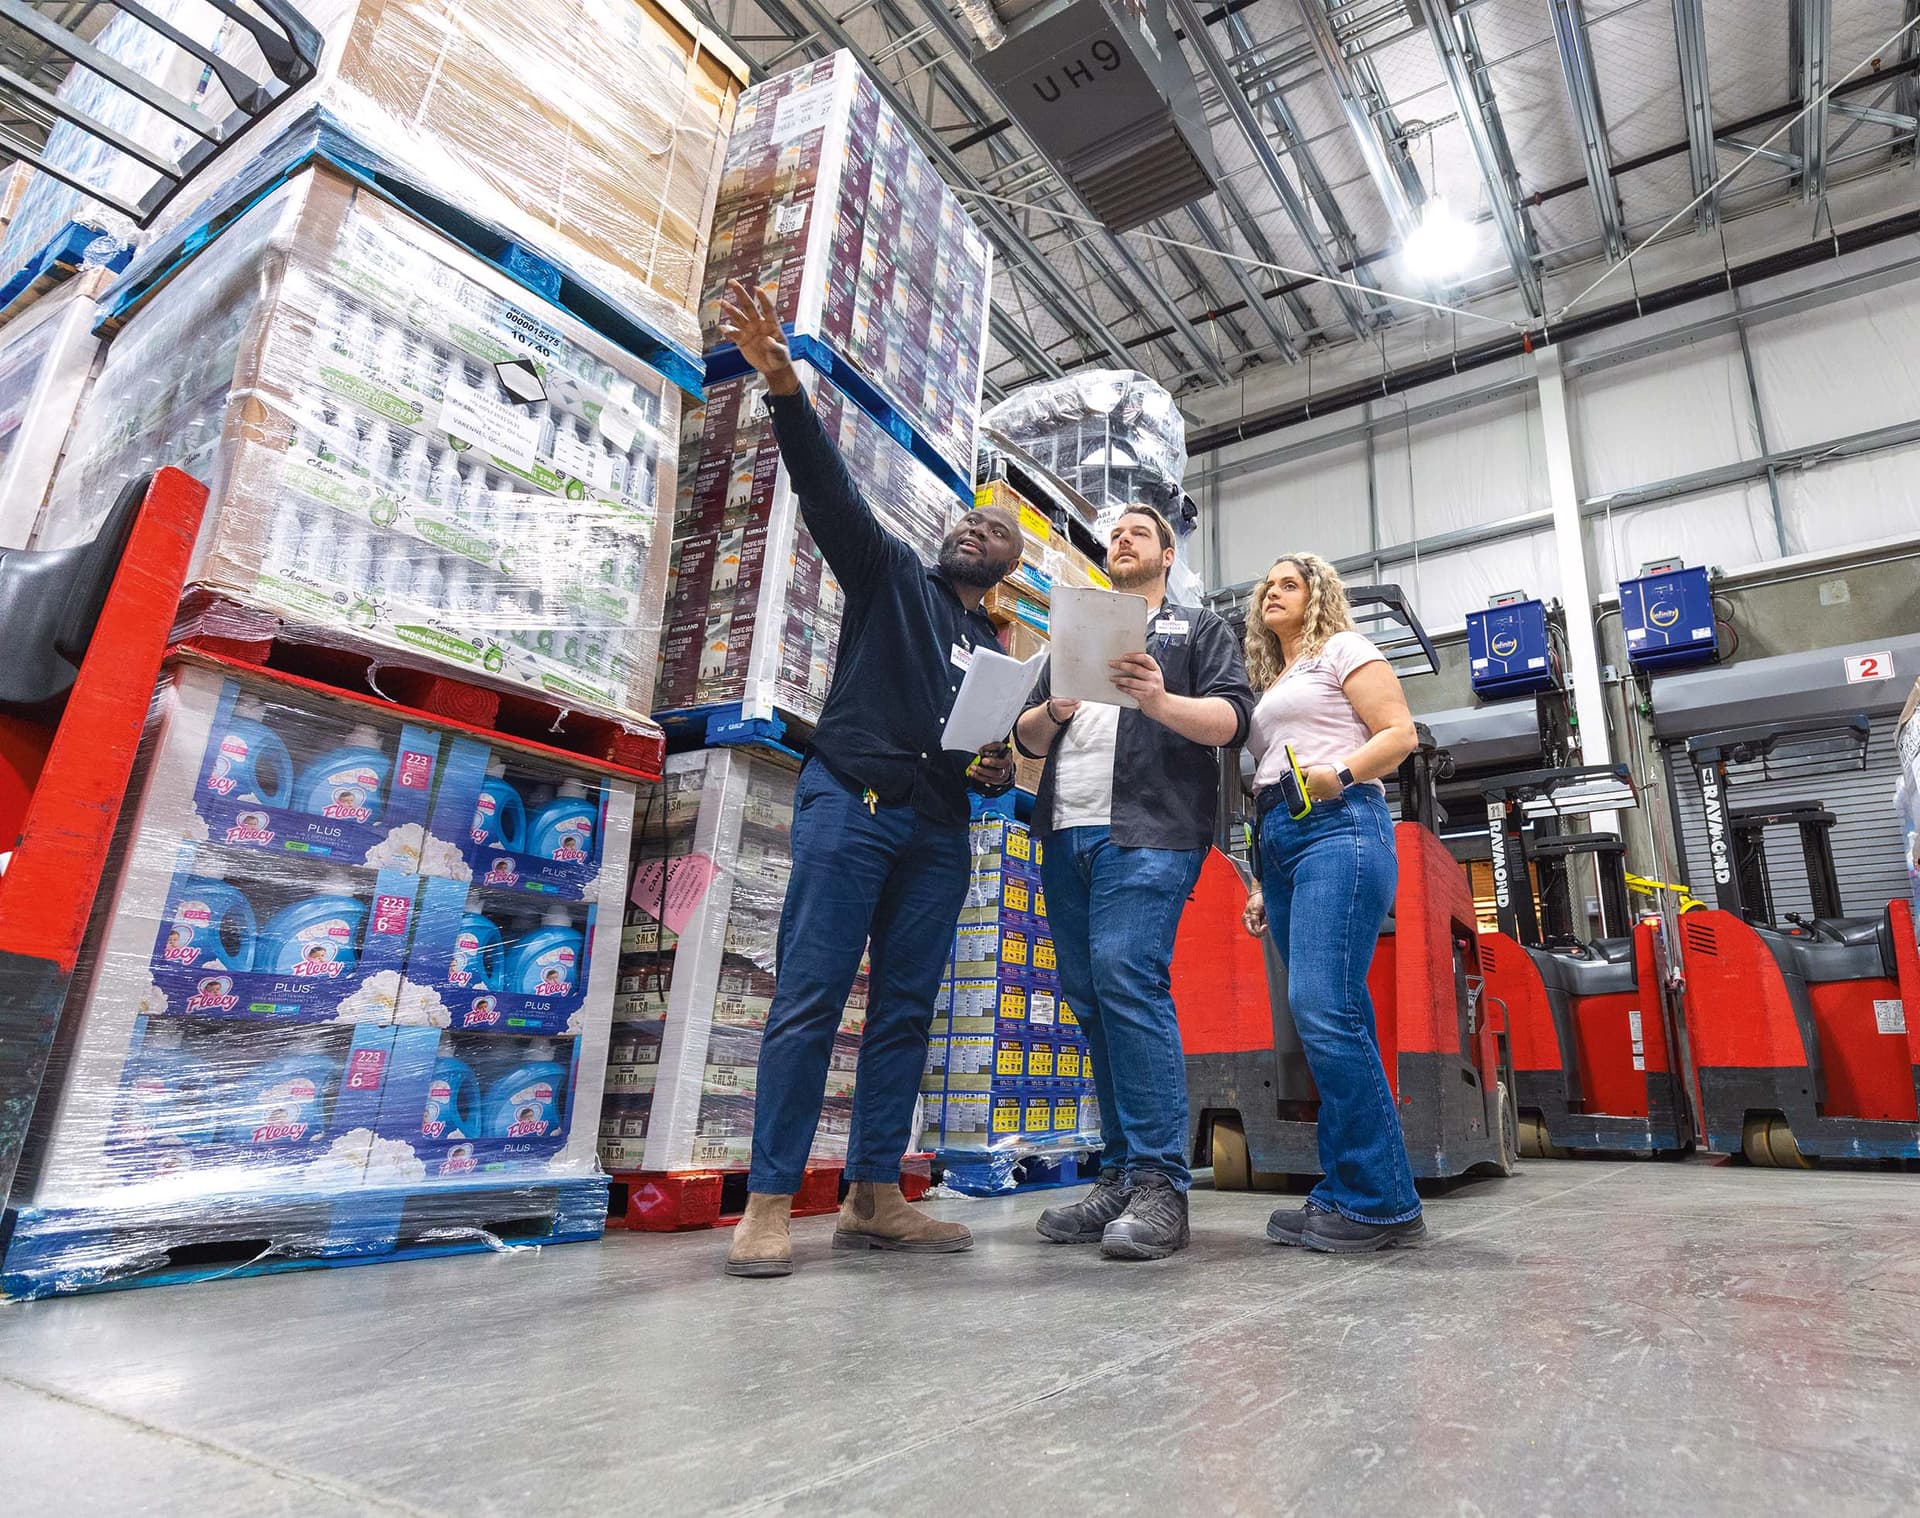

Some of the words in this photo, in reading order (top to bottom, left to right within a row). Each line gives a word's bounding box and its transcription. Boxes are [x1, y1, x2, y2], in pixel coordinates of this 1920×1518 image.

[1032, 39, 1121, 103] UH9
[505, 311, 561, 347] 0000015475
[511, 330, 525, 344] 10
[534, 345, 551, 358] 40
[724, 518, 736, 526] 120
[685, 539, 712, 549] KIRKLAND
[280, 568, 322, 589] Chosen
[427, 618, 462, 636] Chosen
[671, 623, 699, 633] KIRKLAND
[400, 628, 439, 647] AVOCADO
[1859, 658, 1879, 678] 2
[697, 690, 709, 699] 120
[406, 753, 428, 766] 223
[401, 772, 413, 786] 6
[1704, 769, 1713, 784] 4
[321, 804, 373, 824] Fleecy
[1490, 805, 1501, 818] 11
[226, 827, 275, 845] Fleecy
[307, 823, 342, 838] PLUS
[1703, 784, 1731, 884] RAYMOND
[1489, 820, 1510, 908] RAYMOND
[542, 866, 567, 878] PLUS
[383, 897, 405, 909] 223
[377, 917, 388, 932] 6
[292, 959, 345, 978] Fleecy
[274, 983, 311, 993] PLUS
[186, 994, 240, 1014] Fleecy
[524, 1001, 551, 1011] PLUS
[624, 1001, 649, 1014] SALSA
[720, 1001, 746, 1015] SALSA
[463, 1011, 501, 1027] Fleecy
[1001, 1042, 1009, 1050] 101
[1032, 1043, 1040, 1051] 101
[357, 1050, 381, 1063] 223
[351, 1072, 363, 1087] 6
[613, 1074, 638, 1086] SALSA
[712, 1074, 738, 1087] SALSA
[997, 1098, 1006, 1107] 101
[252, 1122, 308, 1144] Fleecy
[507, 1120, 549, 1137] Fleecy
[503, 1143, 531, 1153] PLUS
[600, 1147, 625, 1160] SALSA
[701, 1146, 729, 1160] SALSA
